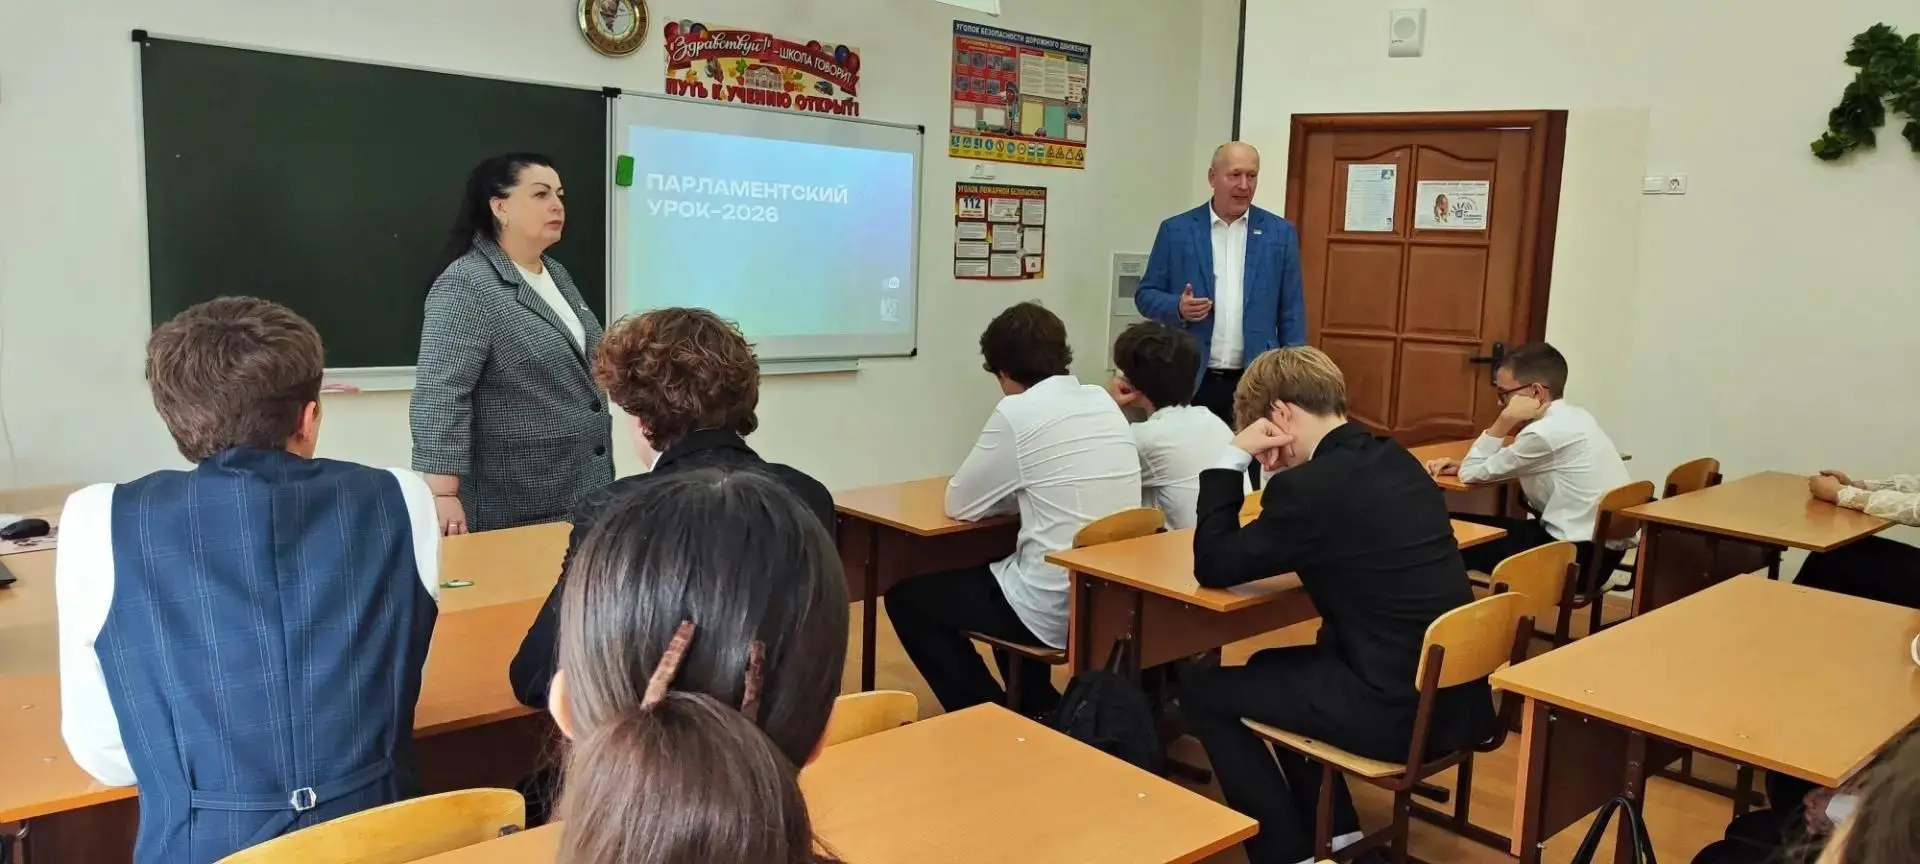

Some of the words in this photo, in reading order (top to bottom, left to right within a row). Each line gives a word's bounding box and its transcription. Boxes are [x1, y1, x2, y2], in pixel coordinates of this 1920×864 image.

[814, 57, 852, 83] ГОВОРИТ
[665, 78, 709, 99] ПУТЬ
[712, 84, 723, 101] К
[726, 85, 792, 109] УЧЕНИЮ
[794, 94, 860, 117] ОТКРЫТ!
[646, 173, 849, 204] ПАРЛАМЕНТСКИЙ
[647, 199, 779, 223] УРОК-2026
[963, 197, 981, 209] 112
